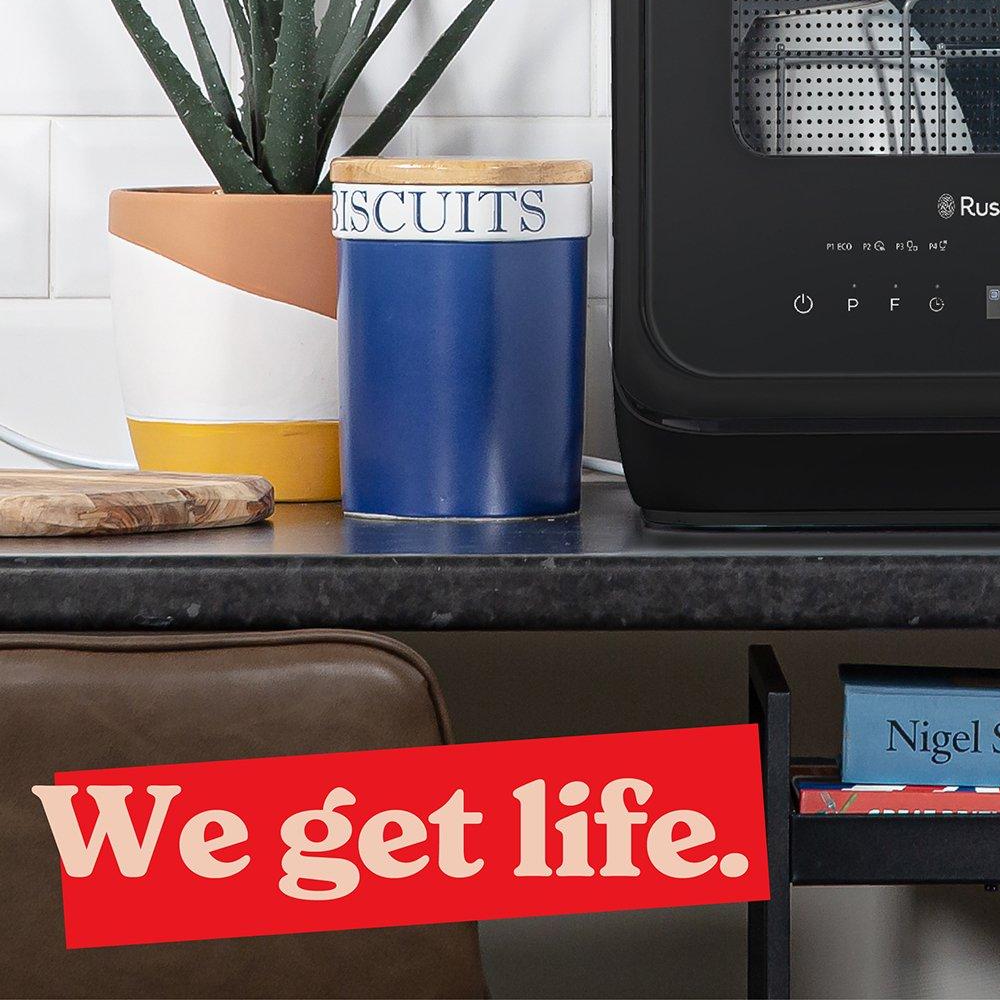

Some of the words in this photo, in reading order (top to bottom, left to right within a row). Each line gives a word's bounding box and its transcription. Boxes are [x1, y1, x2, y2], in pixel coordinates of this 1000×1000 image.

[826, 242, 835, 251] P1
[837, 242, 853, 251] ECO
[862, 242, 872, 251] P2
[895, 242, 905, 251] P3
[928, 242, 938, 251] P4
[847, 298, 859, 312] P
[890, 298, 901, 312] F
[886, 719, 983, 765] Nigel
